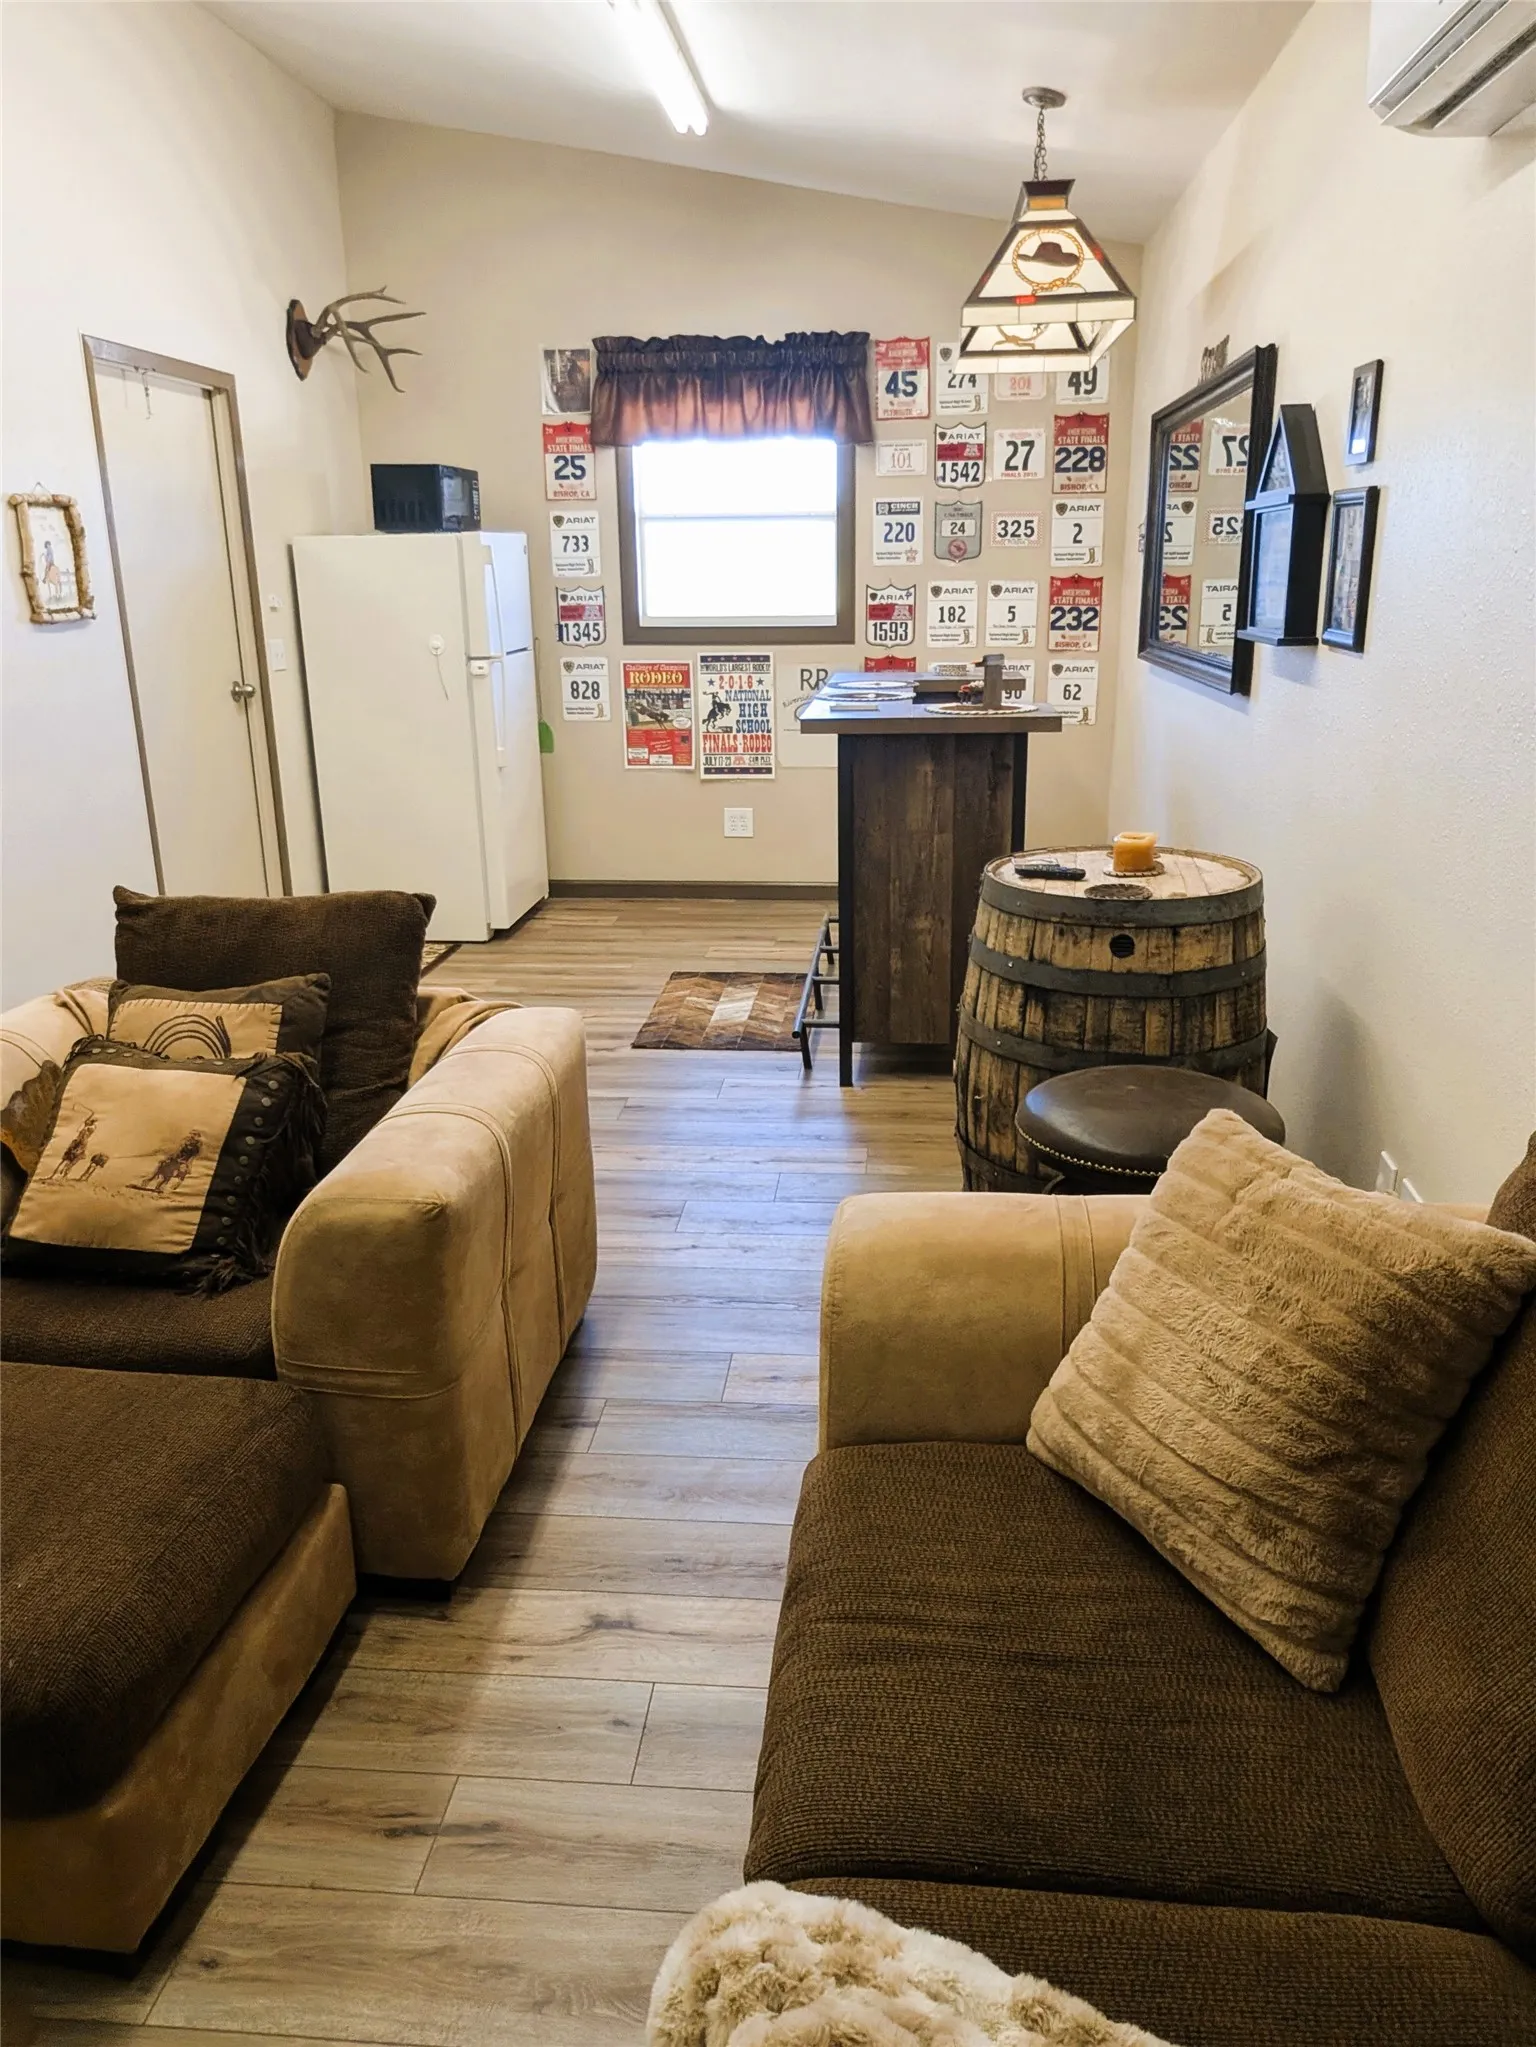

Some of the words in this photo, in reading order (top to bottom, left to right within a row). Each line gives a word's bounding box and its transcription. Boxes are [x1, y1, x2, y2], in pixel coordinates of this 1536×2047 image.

[885, 370, 918, 398] 45
[1067, 364, 1098, 396] 49
[948, 432, 981, 440] ARIAT
[1058, 435, 1079, 445] STATE
[1080, 434, 1105, 445] FINALS
[547, 444, 567, 453] STATE
[1004, 440, 1036, 472] 27
[553, 455, 586, 481] 25
[1055, 446, 1106, 473] 228
[941, 461, 981, 483] 1542
[1069, 504, 1101, 512] ARIAT
[565, 516, 596, 525] ARIAT
[950, 521, 966, 536] 24
[997, 519, 1035, 539] 325
[883, 522, 915, 544] 220
[1072, 522, 1083, 545] 2
[562, 535, 590, 553] 733
[569, 595, 600, 603] ARIAT
[943, 587, 975, 595] ARIAT
[1053, 596, 1074, 605] STATE
[1075, 596, 1099, 605] FINALS
[938, 605, 966, 624] 182
[1007, 605, 1017, 624] 5
[1050, 606, 1100, 632] 232
[563, 622, 601, 643] 1345
[872, 621, 909, 642] 1593
[575, 663, 606, 671] ARIAT
[1002, 664, 1032, 672] ARIAT
[630, 671, 684, 685] RODEO
[570, 680, 601, 701] 828
[725, 690, 772, 702] NATIONAL
[1062, 684, 1082, 701] 62
[739, 703, 768, 718] HIGH
[736, 719, 772, 734] SCHOOL
[703, 734, 739, 754] FINALS
[742, 734, 772, 754] RODEO
[703, 756, 718, 767] JULY
